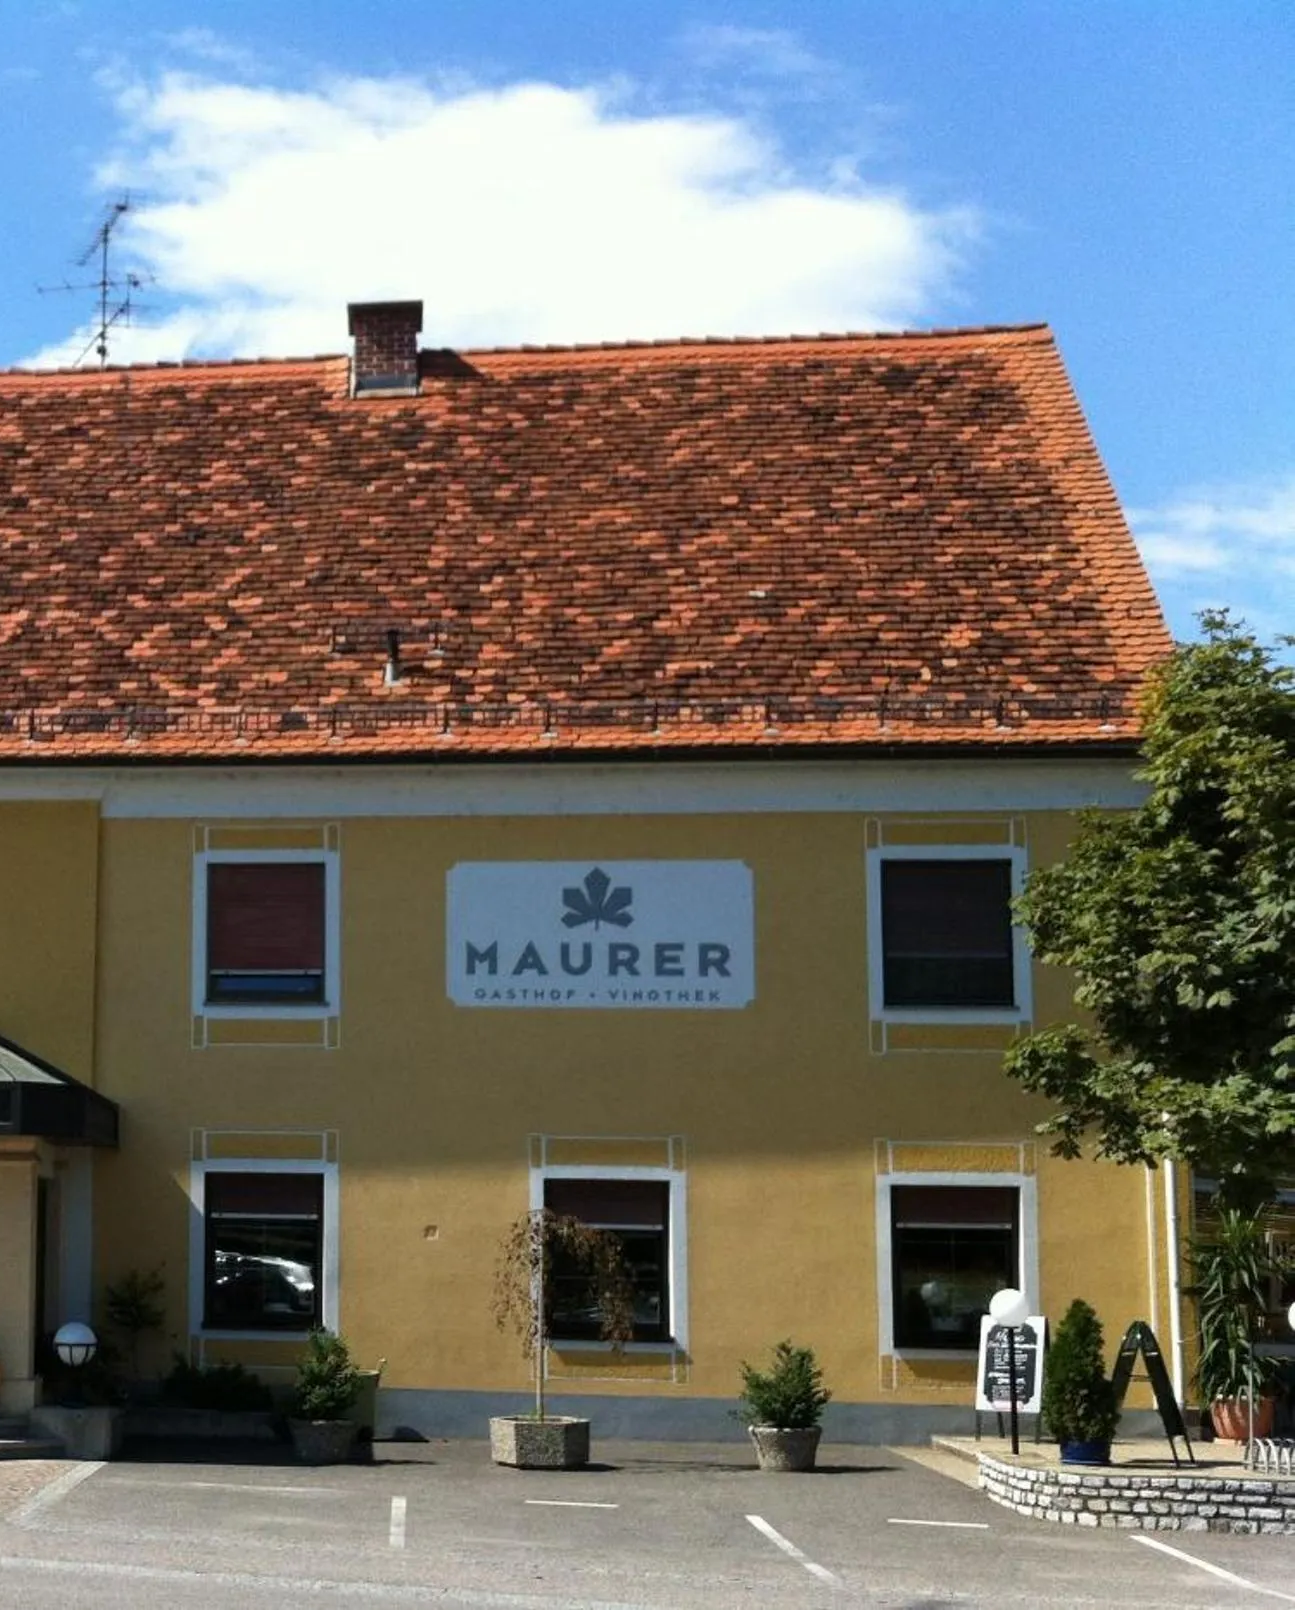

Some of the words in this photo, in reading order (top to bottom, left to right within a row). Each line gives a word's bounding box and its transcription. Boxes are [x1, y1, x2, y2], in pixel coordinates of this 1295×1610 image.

[465, 940, 731, 977] MAURER
[474, 988, 576, 1001] GASTHOF
[608, 989, 721, 1001] VINOTHEK
